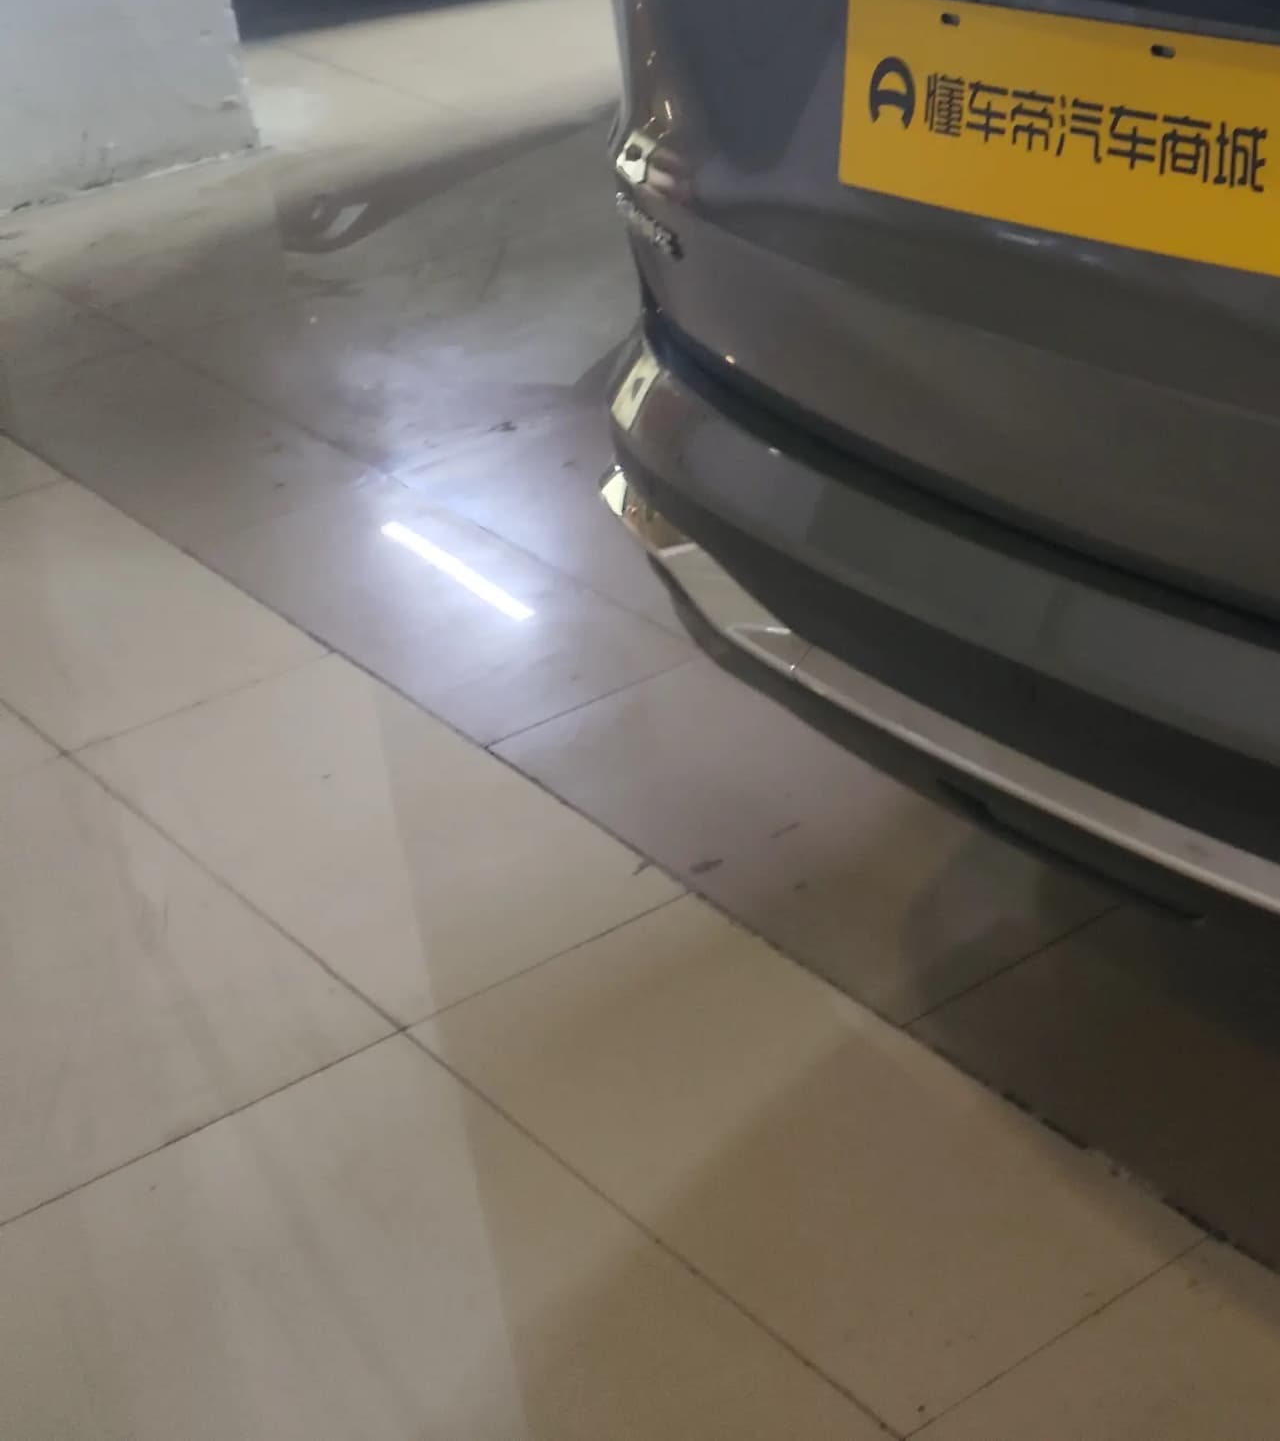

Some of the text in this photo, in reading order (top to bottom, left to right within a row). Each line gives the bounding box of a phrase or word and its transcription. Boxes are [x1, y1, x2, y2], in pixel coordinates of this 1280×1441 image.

[924, 71, 1268, 193] 懂车帝汽车商城
